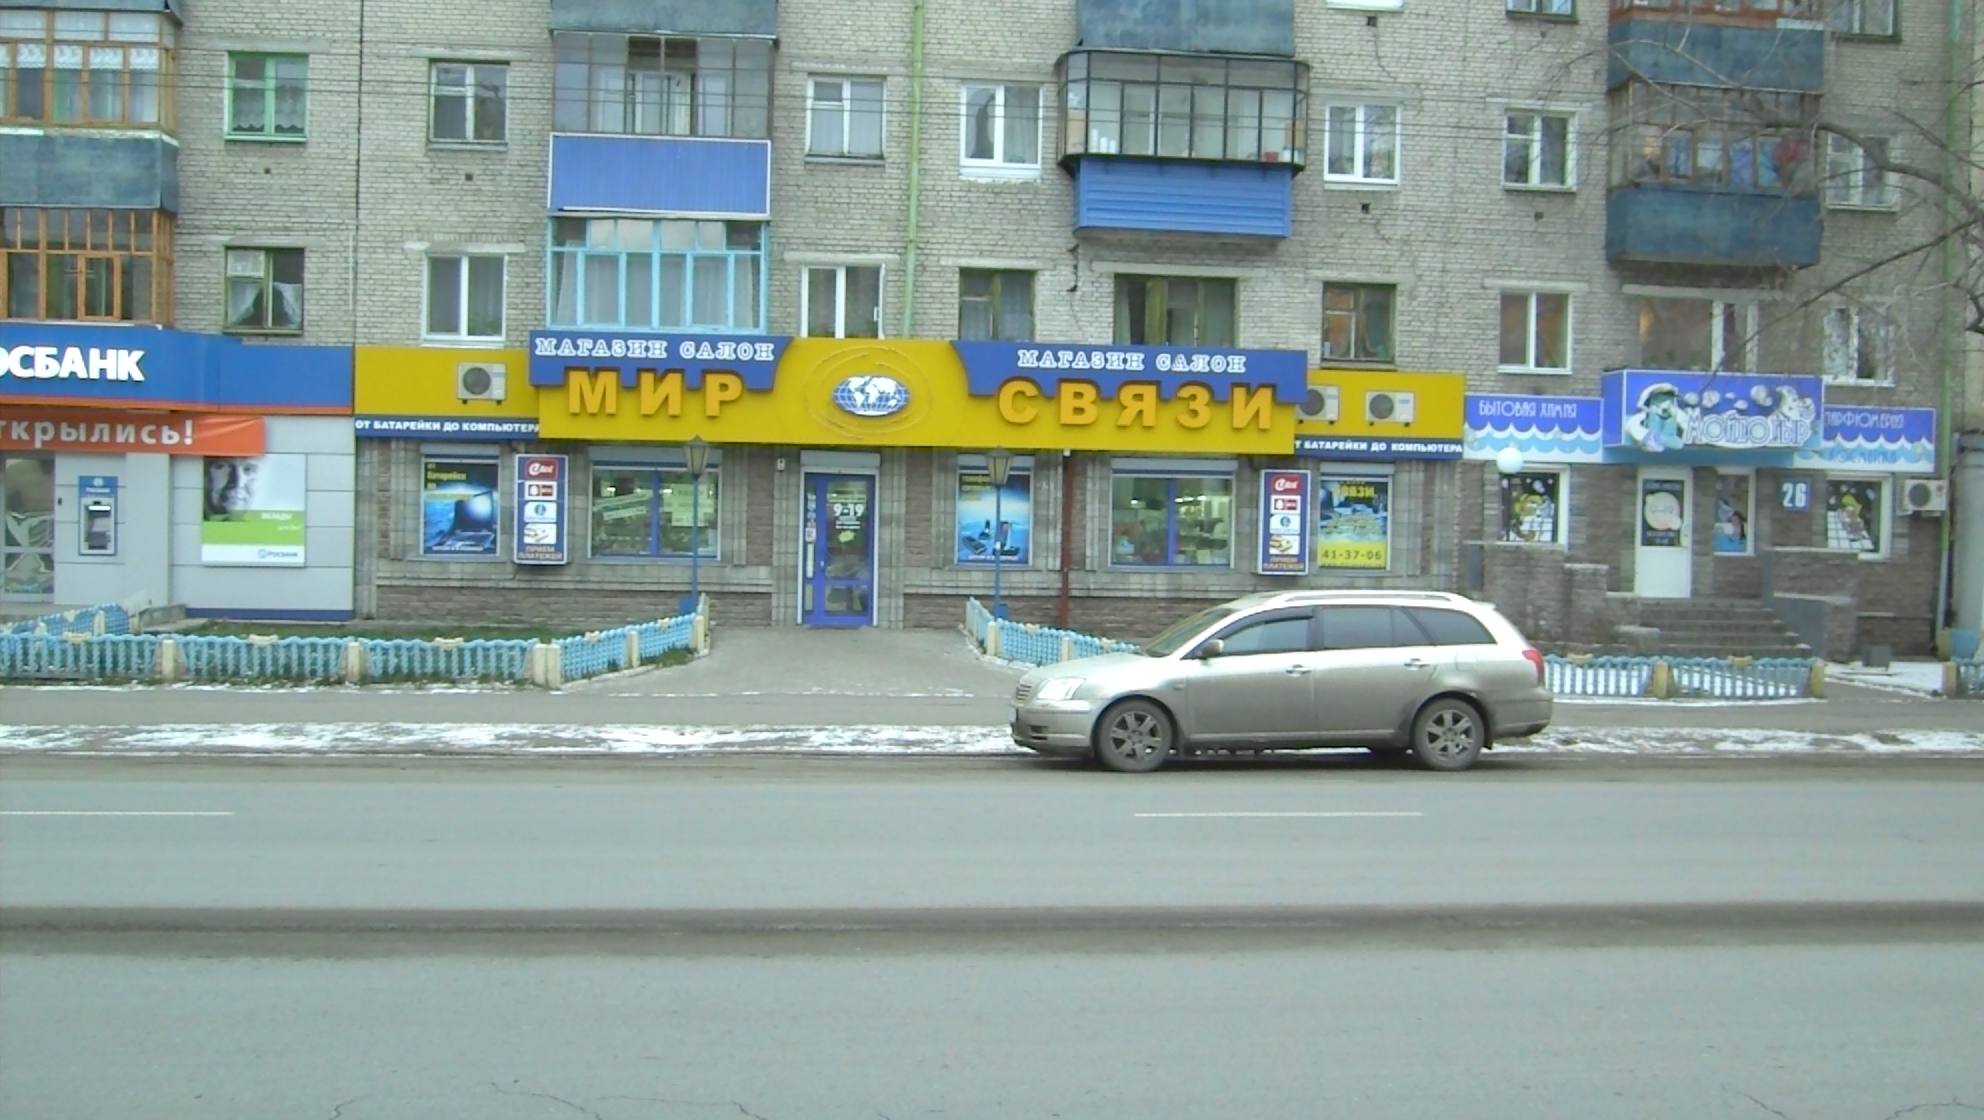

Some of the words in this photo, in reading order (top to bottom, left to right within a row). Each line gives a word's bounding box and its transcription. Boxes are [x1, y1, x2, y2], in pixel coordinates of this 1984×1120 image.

[534, 337, 668, 358] МАГАЗИН
[678, 341, 775, 362] САЛОН
[1017, 349, 1145, 371] МАГАЗИН
[1155, 353, 1248, 374] САЛОН
[567, 369, 744, 418] МИР
[998, 379, 1274, 430] СВЯЗИ
[355, 420, 372, 431] ОТ
[373, 420, 441, 432] БАТАРЕЙКИ
[443, 422, 459, 433] ДО
[1305, 440, 1367, 452] БАТАРЕЙКИ
[1371, 443, 1387, 455] ДО
[1391, 443, 1463, 455] КОМПЬЮТЕРА
[1782, 482, 1806, 507] 26
[833, 503, 865, 517] 9-19
[1322, 550, 1382, 560] 41-37-06
